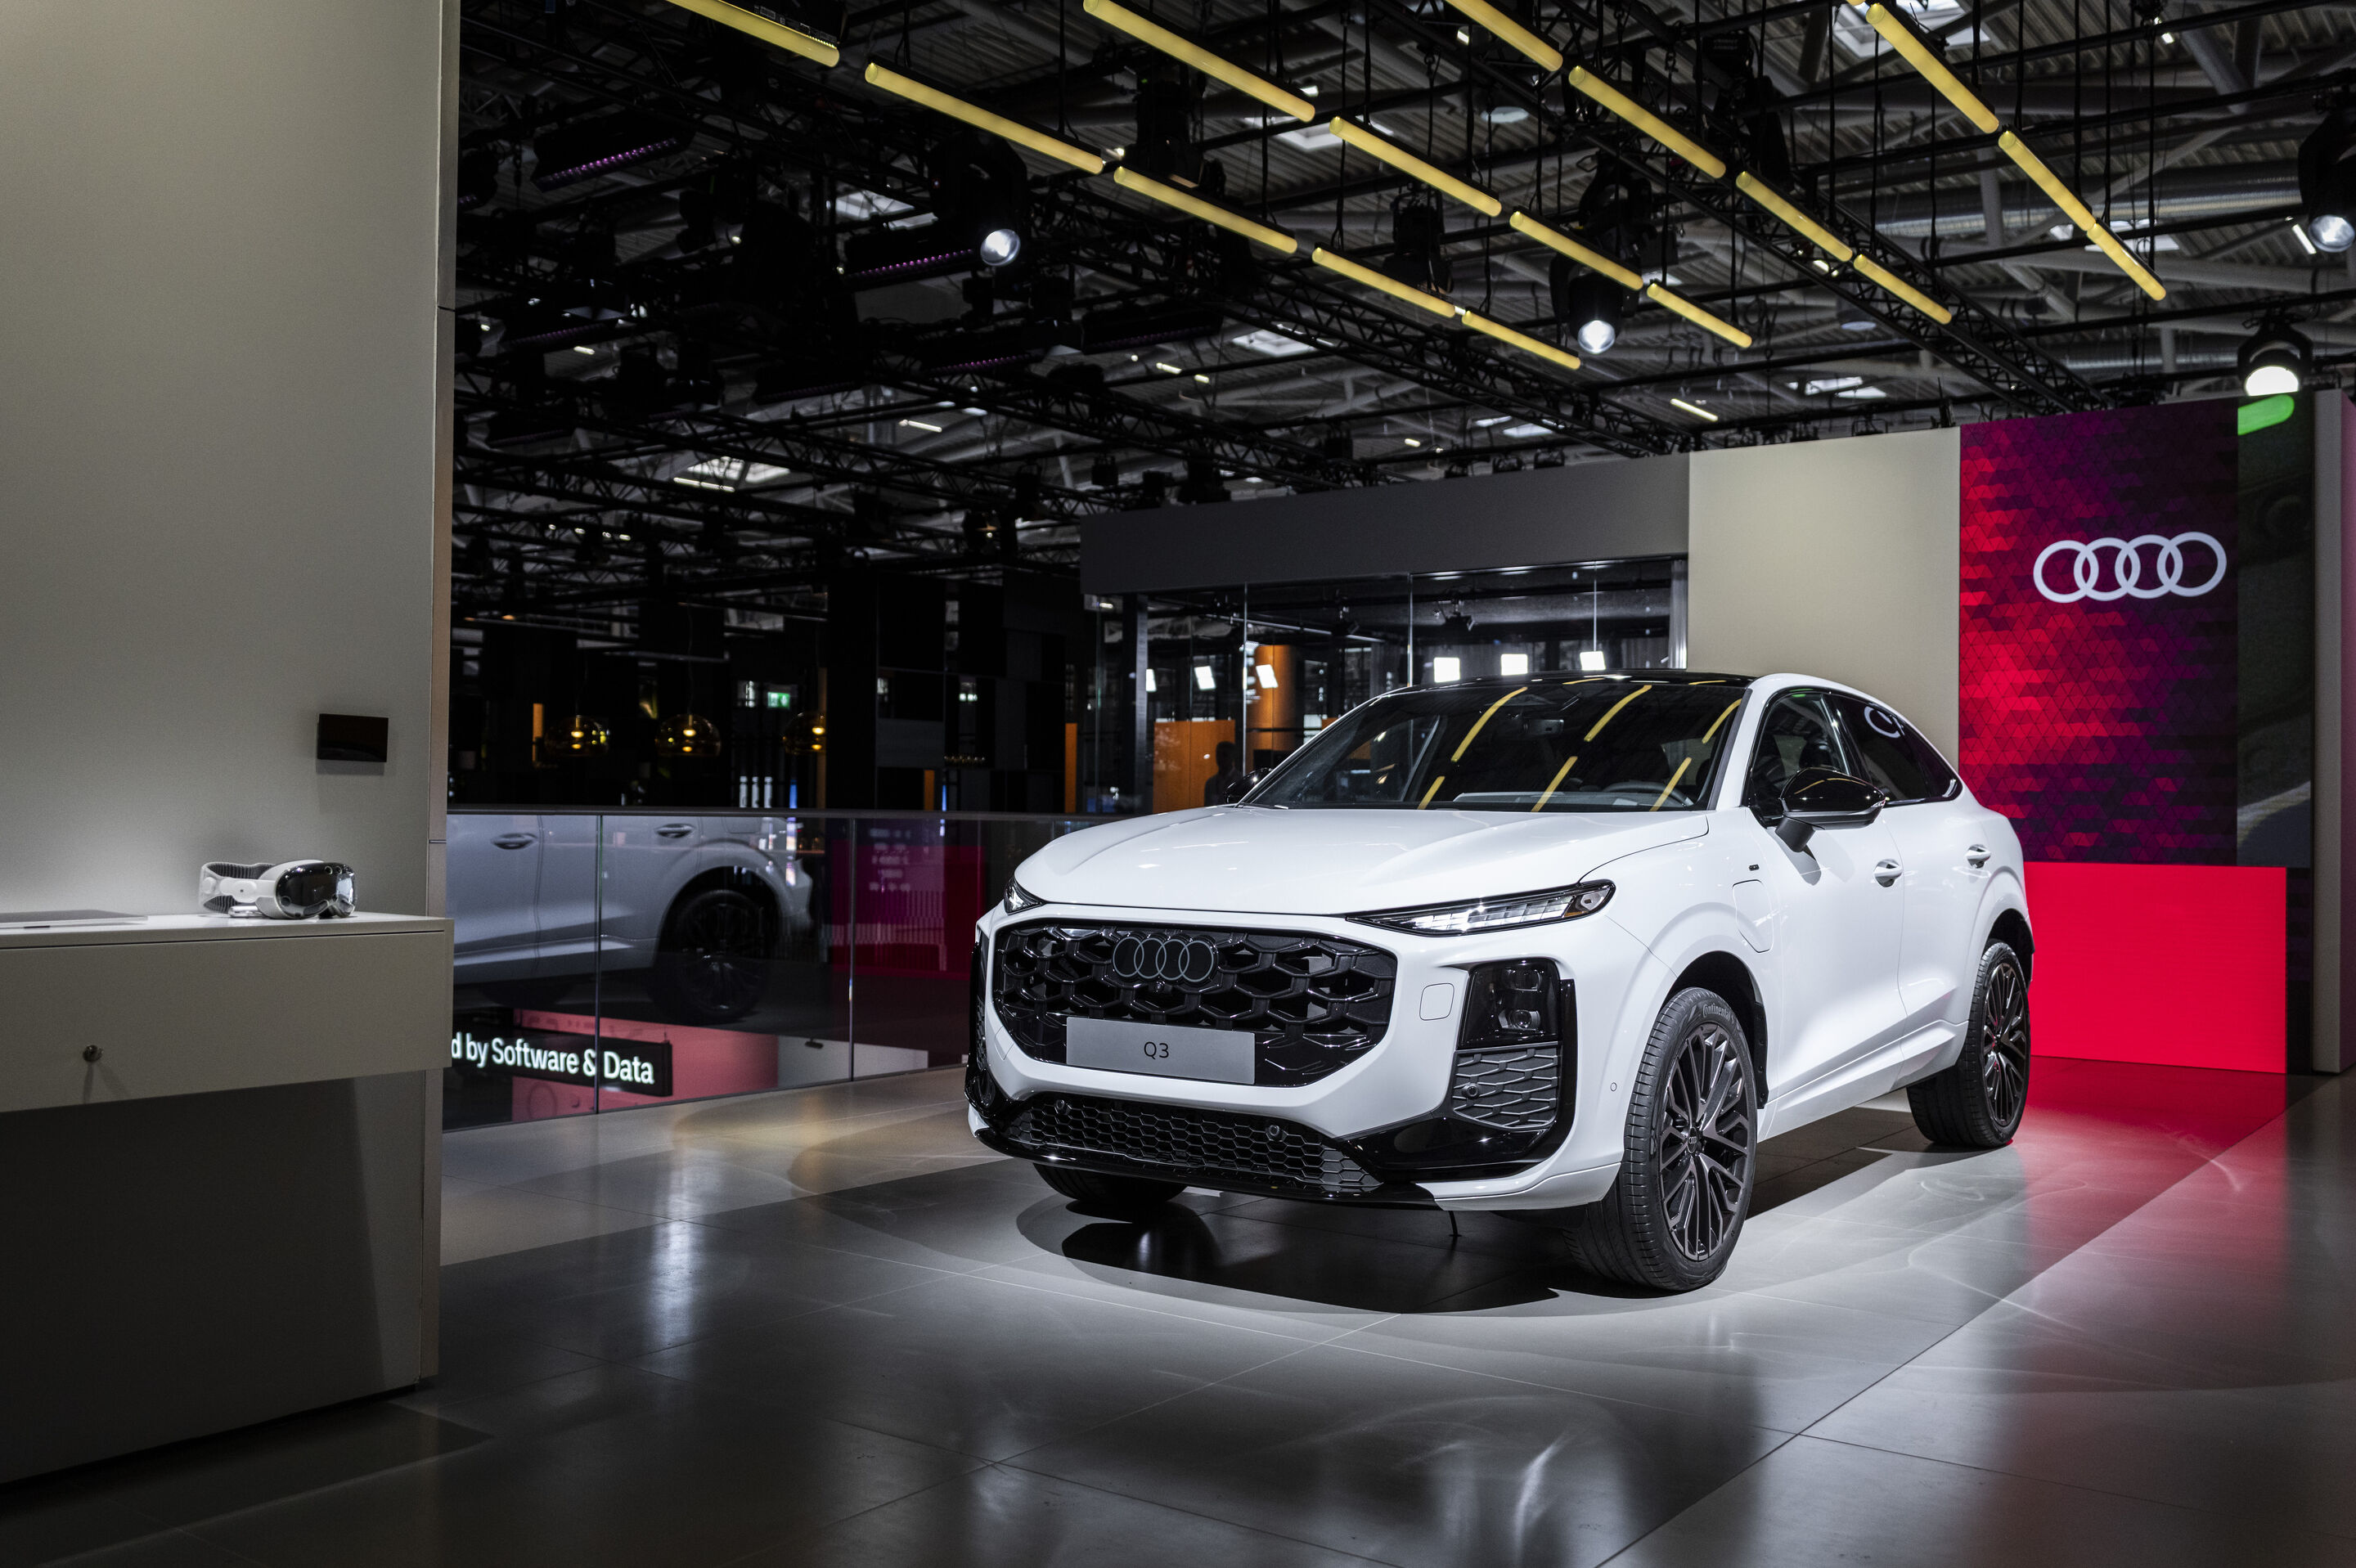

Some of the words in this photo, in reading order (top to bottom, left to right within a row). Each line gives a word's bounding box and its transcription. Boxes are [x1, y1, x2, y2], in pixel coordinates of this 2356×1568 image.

[1702, 1003, 1731, 1022] Continental
[465, 1032, 488, 1067] by
[492, 1037, 579, 1075] Software
[582, 1049, 596, 1076] &
[604, 1051, 654, 1085] Data
[1144, 1041, 1170, 1060] Q3
